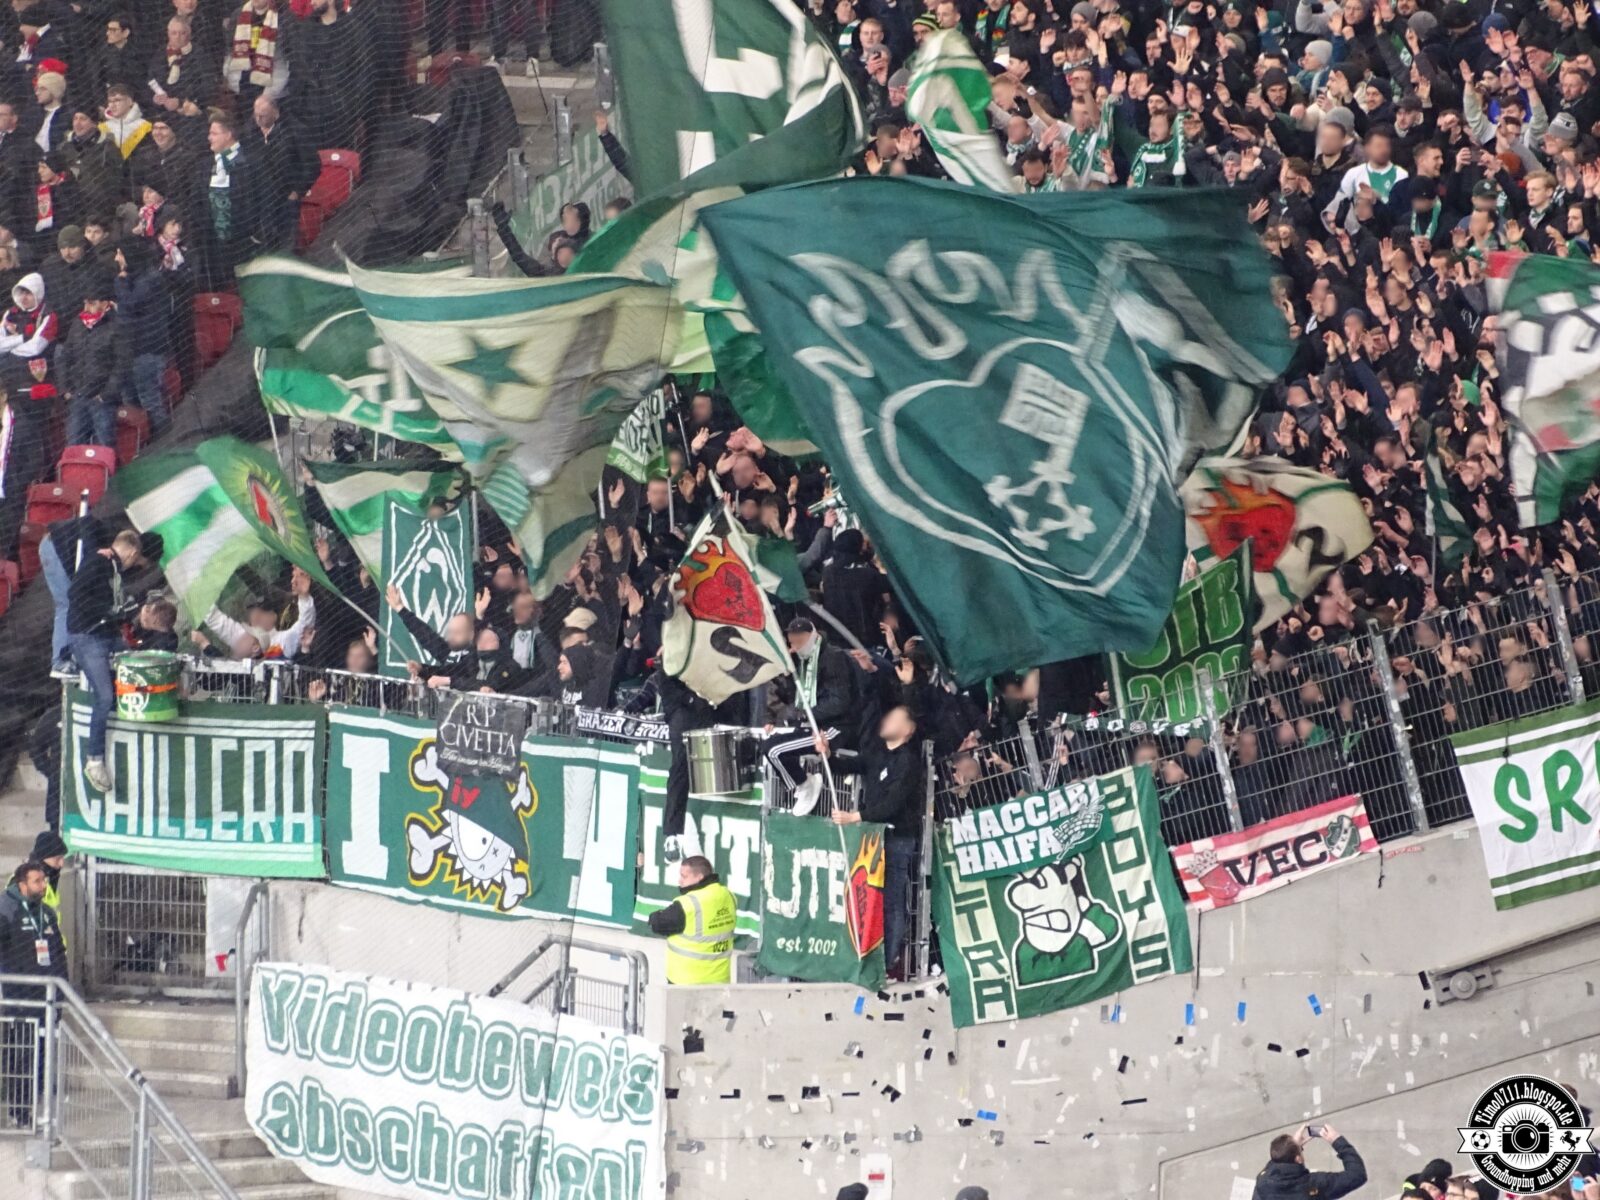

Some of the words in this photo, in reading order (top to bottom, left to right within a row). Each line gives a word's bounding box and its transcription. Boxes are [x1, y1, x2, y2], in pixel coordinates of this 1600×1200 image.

[440, 711, 516, 757] CIVETTA
[72, 722, 315, 844] CAILLERA
[951, 780, 1103, 846] MACCABI
[1493, 739, 1600, 844] SR
[956, 823, 1064, 876] HAIFA
[1100, 774, 1171, 980] BOYS
[776, 936, 804, 952] est.
[808, 936, 838, 956] 2002
[259, 966, 660, 1125] Videobeweis
